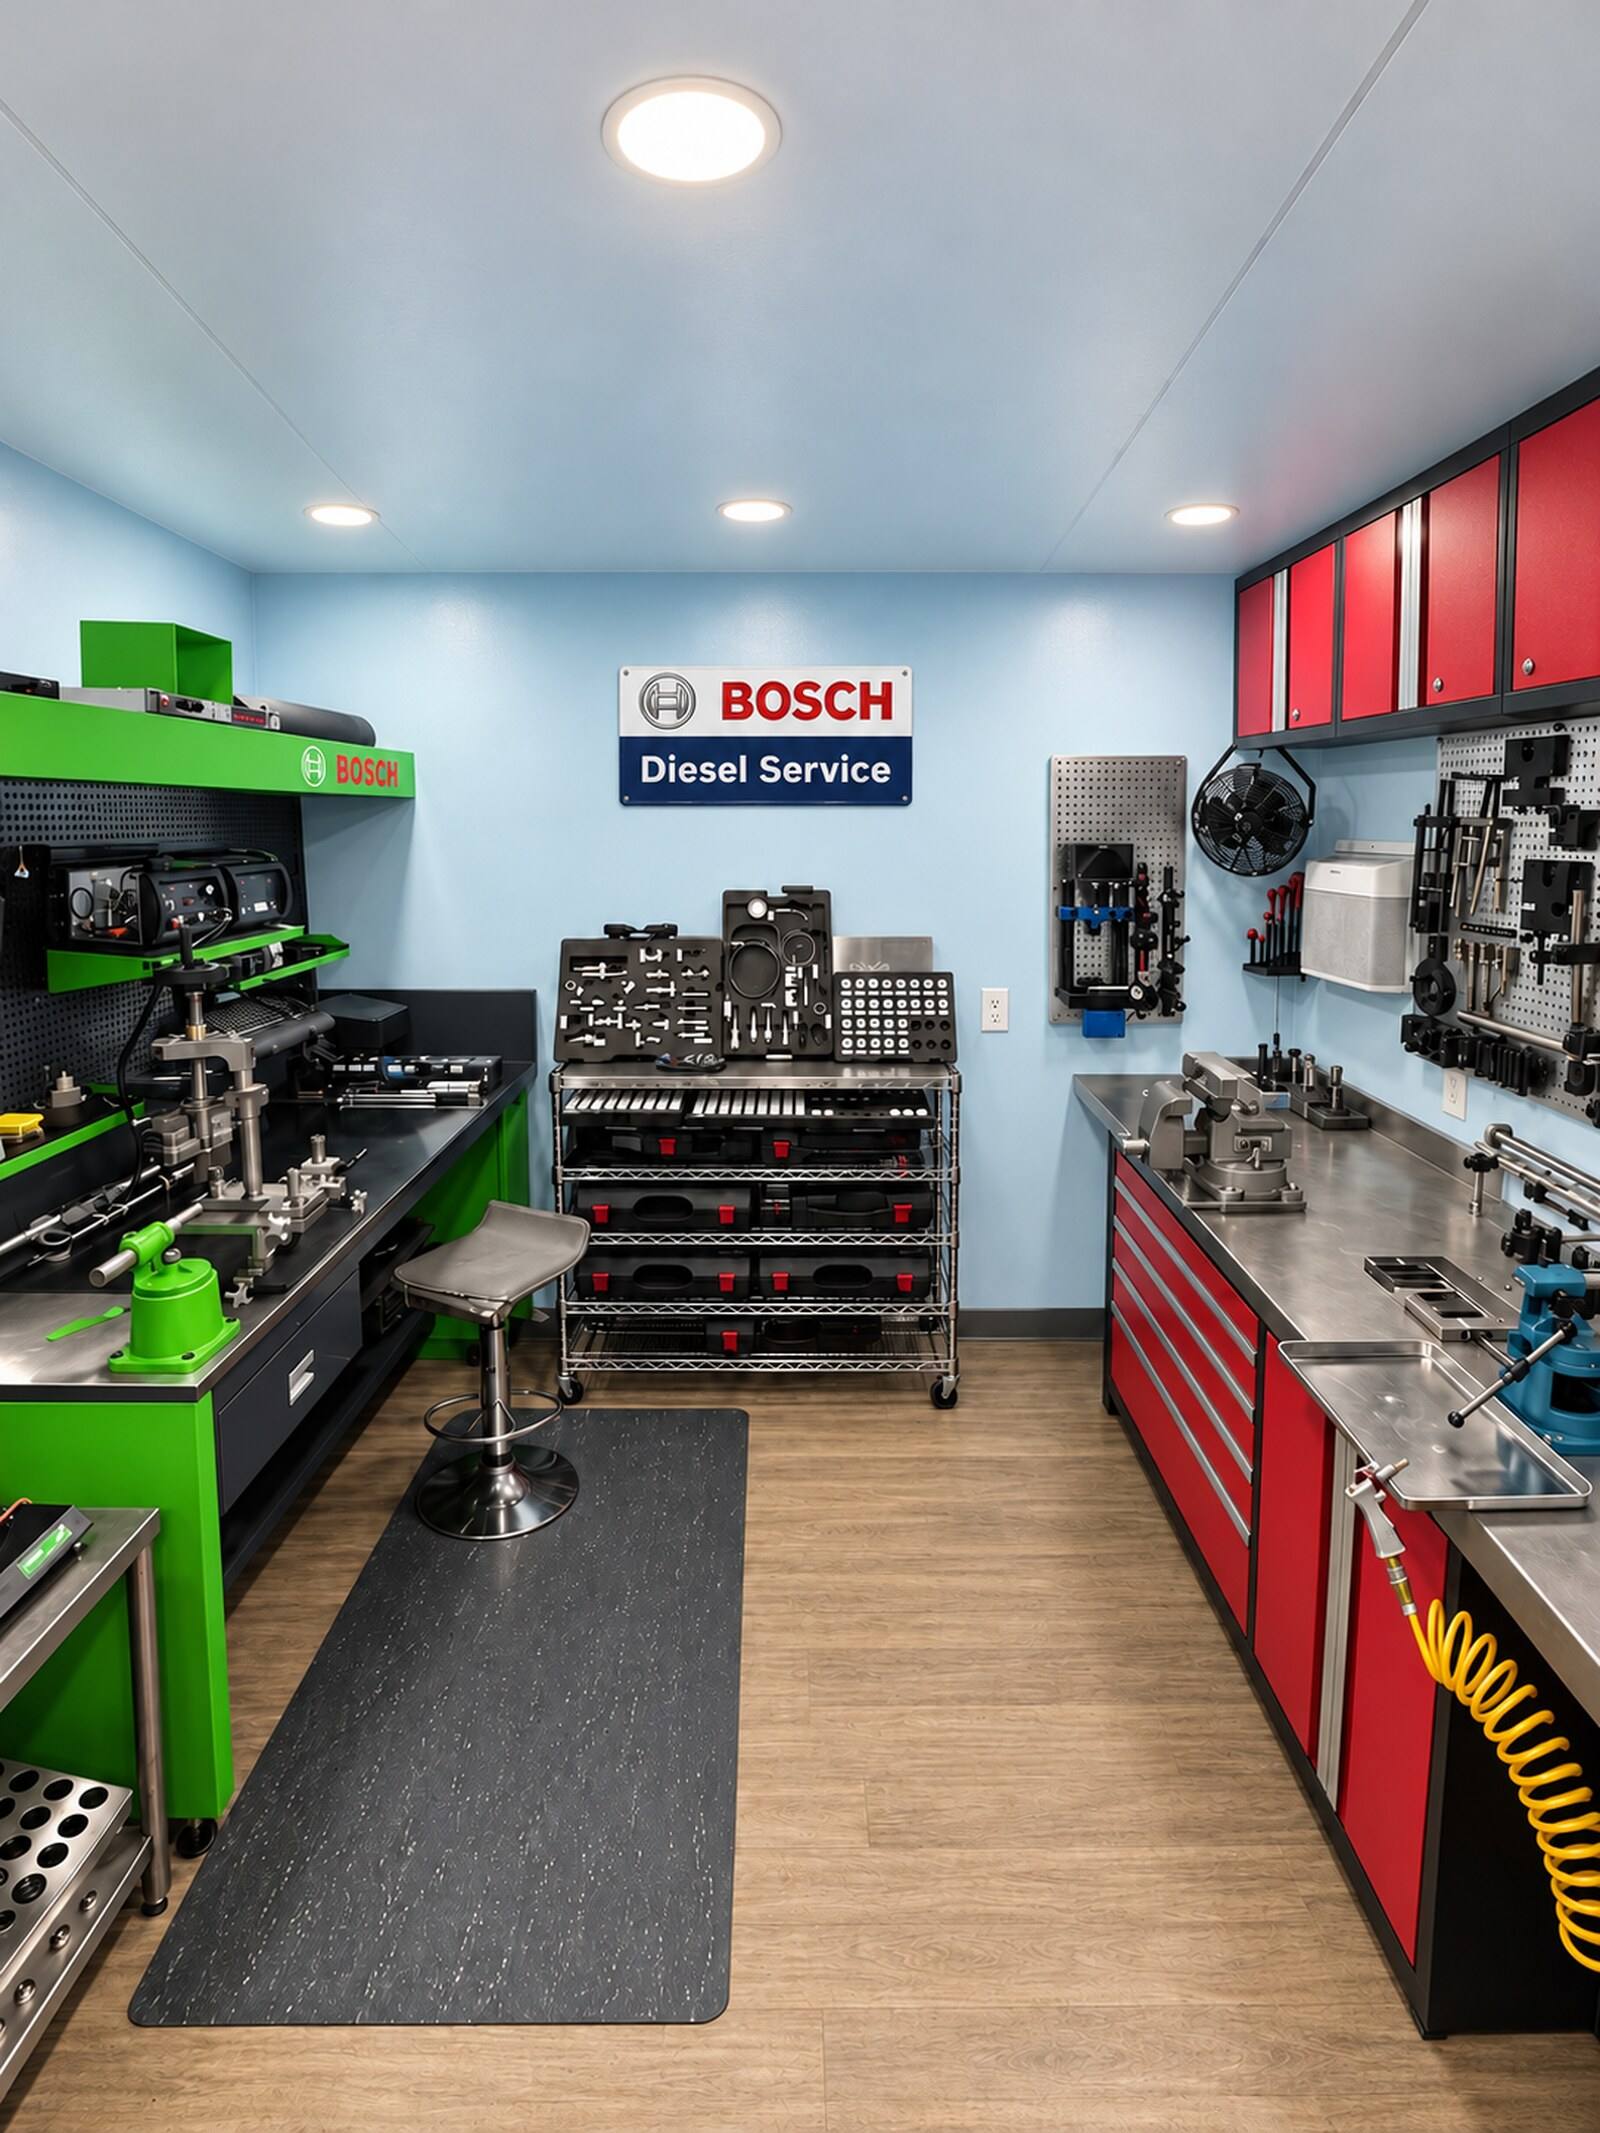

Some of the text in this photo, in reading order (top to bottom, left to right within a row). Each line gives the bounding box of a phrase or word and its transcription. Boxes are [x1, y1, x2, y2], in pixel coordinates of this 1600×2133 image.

[721, 680, 894, 721] BOSCH
[336, 754, 398, 788] BOSCH
[641, 754, 892, 783] Diesel Service
